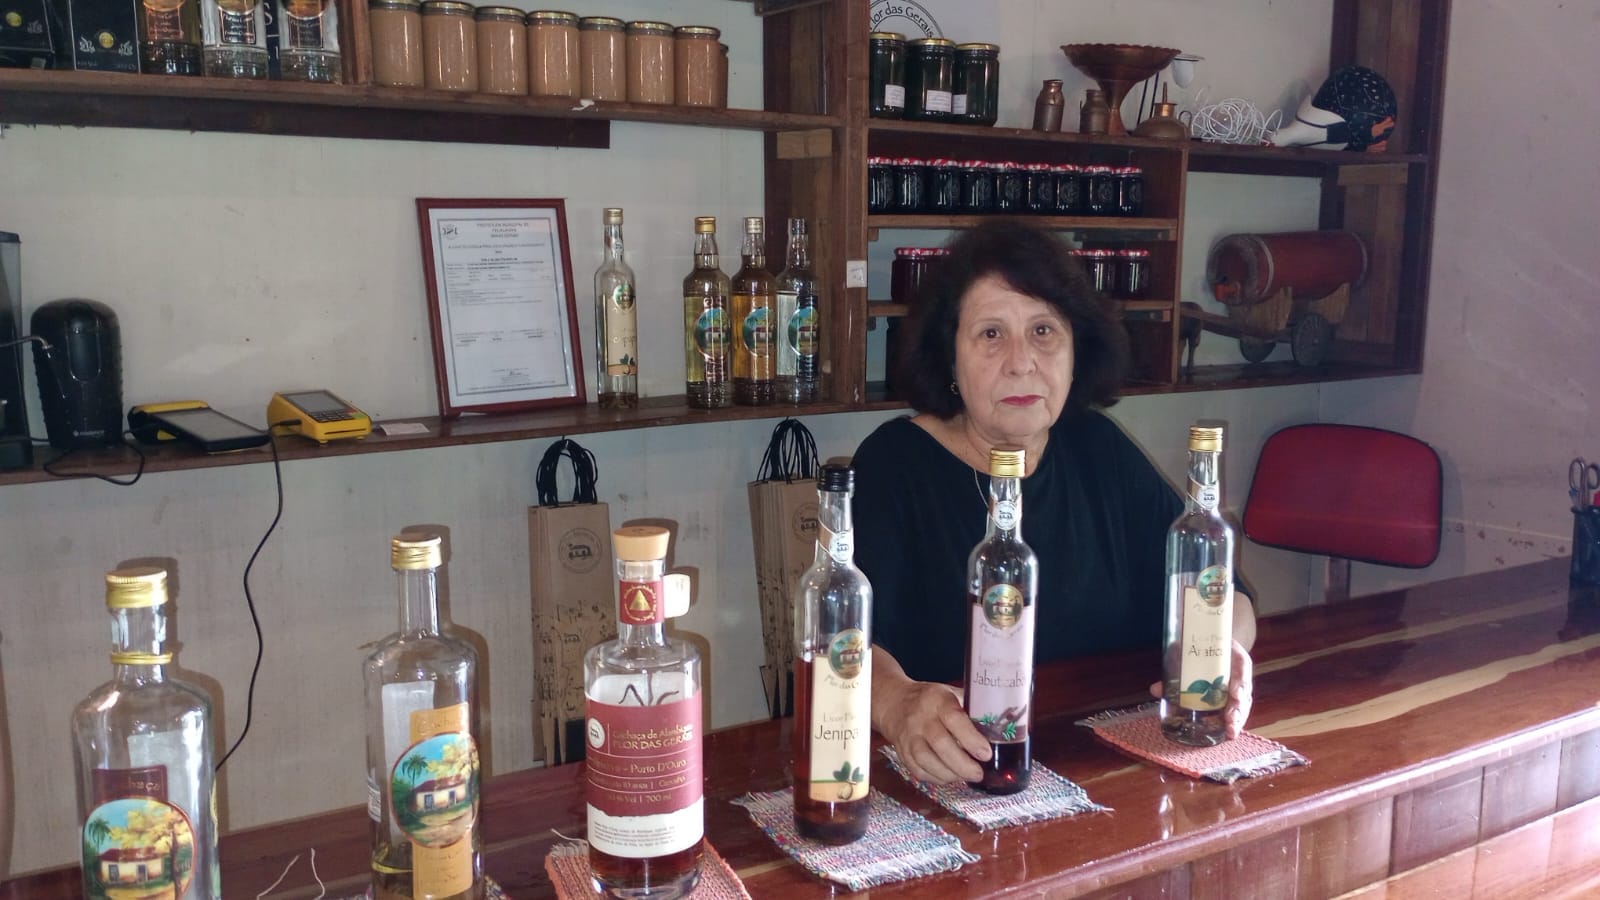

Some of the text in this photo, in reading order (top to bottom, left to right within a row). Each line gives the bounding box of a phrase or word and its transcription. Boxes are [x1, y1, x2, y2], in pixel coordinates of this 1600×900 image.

[885, 1, 903, 15] das
[905, 6, 934, 38] Gerais
[647, 729, 657, 739] de
[814, 724, 860, 751] Jenipa
[613, 740, 639, 750] FLOR
[640, 740, 662, 750] DAS
